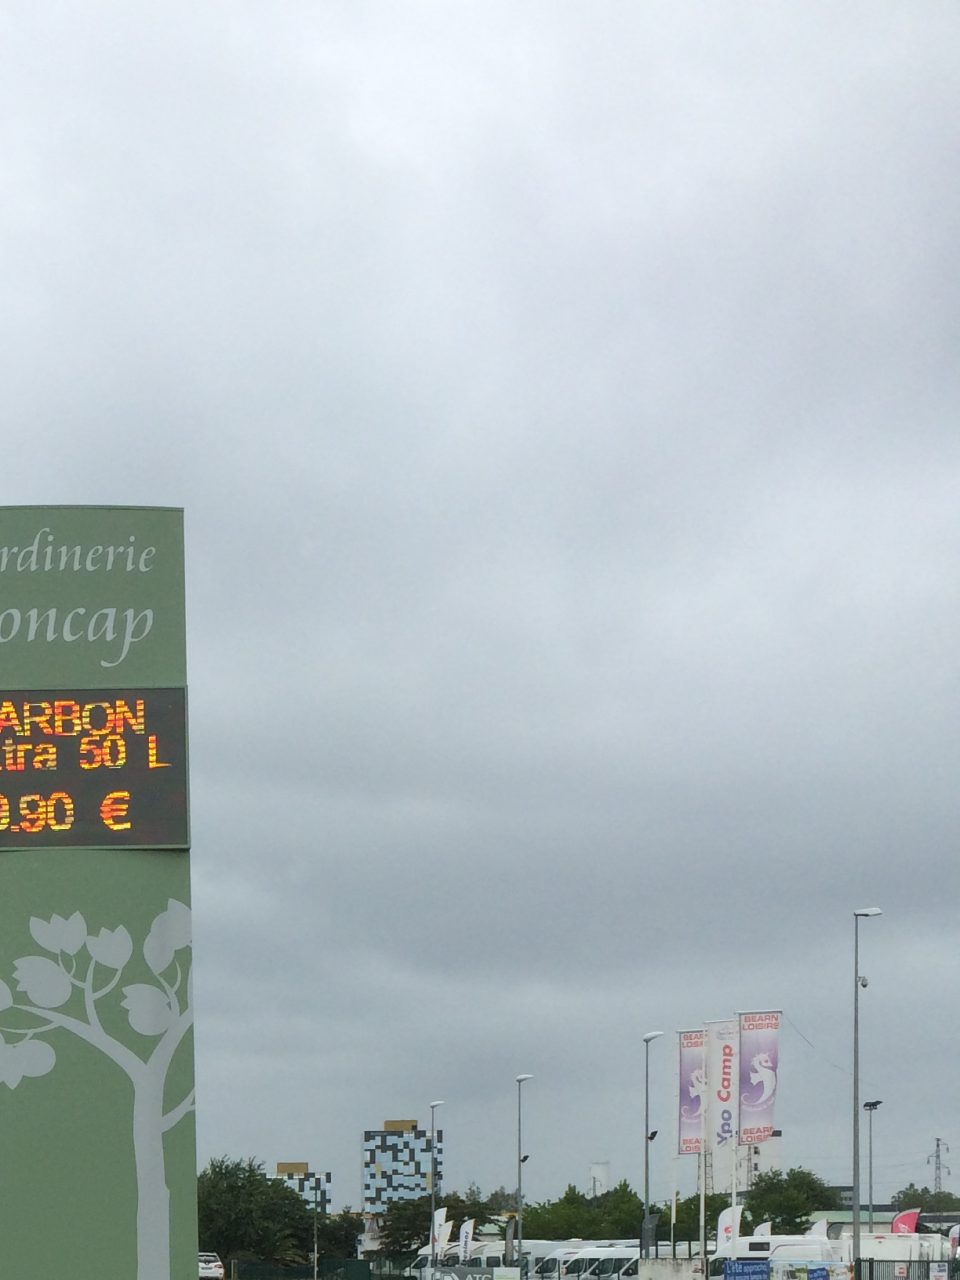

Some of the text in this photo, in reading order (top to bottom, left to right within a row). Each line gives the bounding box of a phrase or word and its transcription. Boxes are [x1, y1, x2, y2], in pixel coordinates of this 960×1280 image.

[79, 734, 127, 770] 50
[148, 735, 172, 768] L
[100, 791, 132, 831] €
[742, 1022, 780, 1031] LOISIRS
[744, 1014, 779, 1022] BEARN
[683, 1033, 704, 1041] BEAR
[717, 1044, 733, 1103] Camp
[716, 1109, 733, 1146] Ypo
[682, 1137, 701, 1145] BEA
